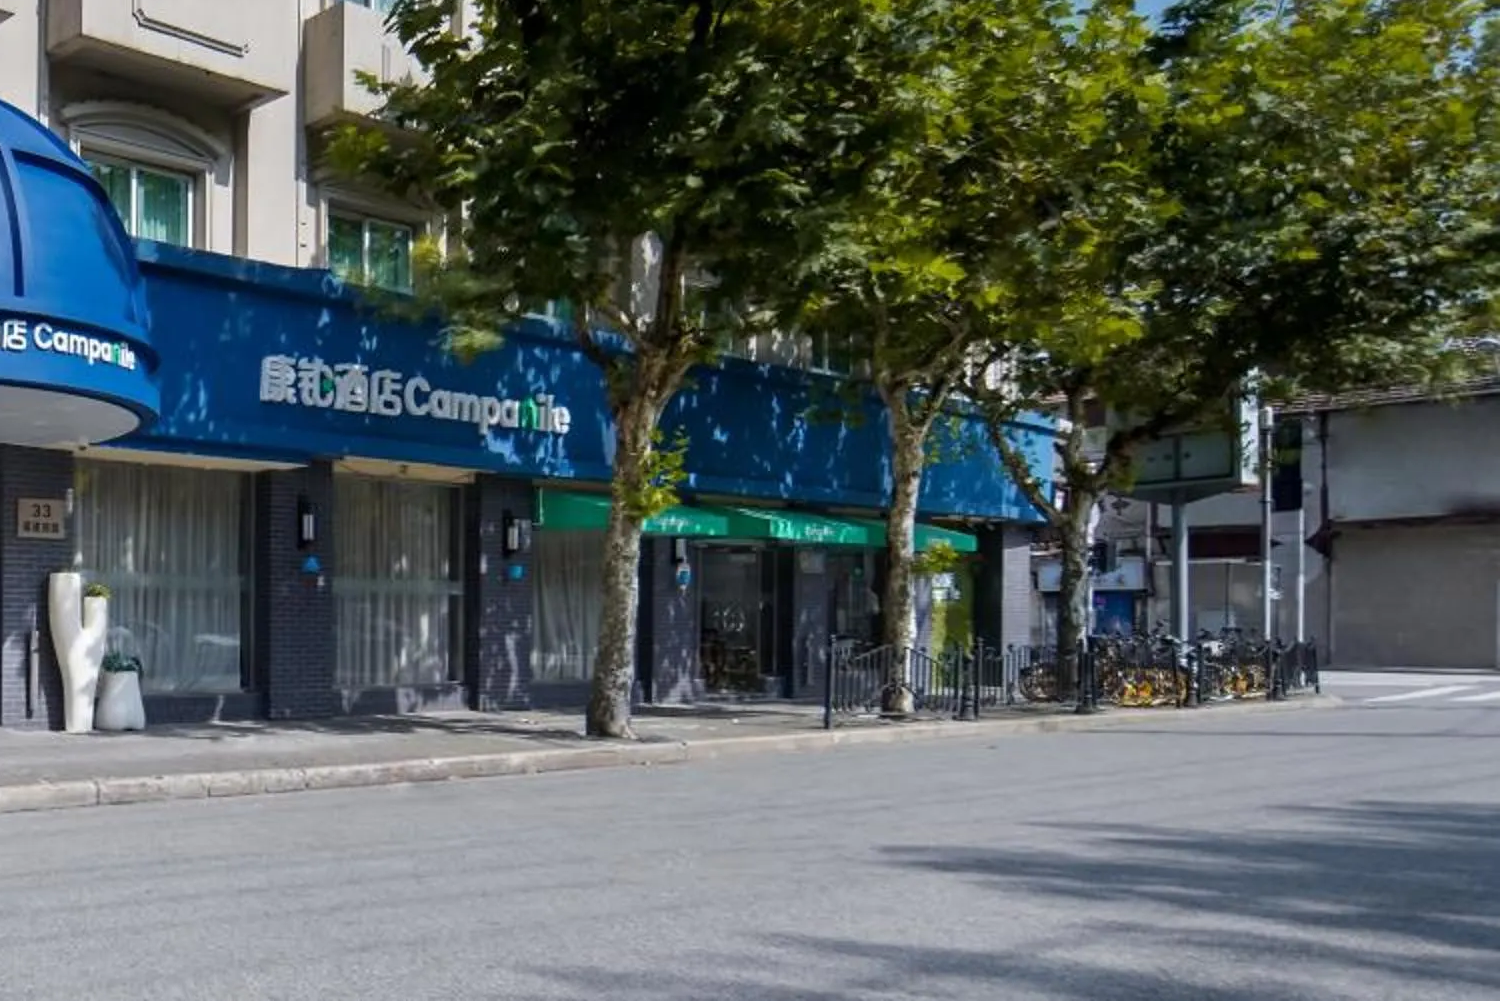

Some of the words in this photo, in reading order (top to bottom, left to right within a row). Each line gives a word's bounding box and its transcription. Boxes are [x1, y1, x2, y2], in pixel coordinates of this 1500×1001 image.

[33, 322, 136, 371] Campanile
[259, 354, 404, 416] 康铂酒店
[404, 375, 571, 436] Campanile
[31, 503, 51, 518] 33
